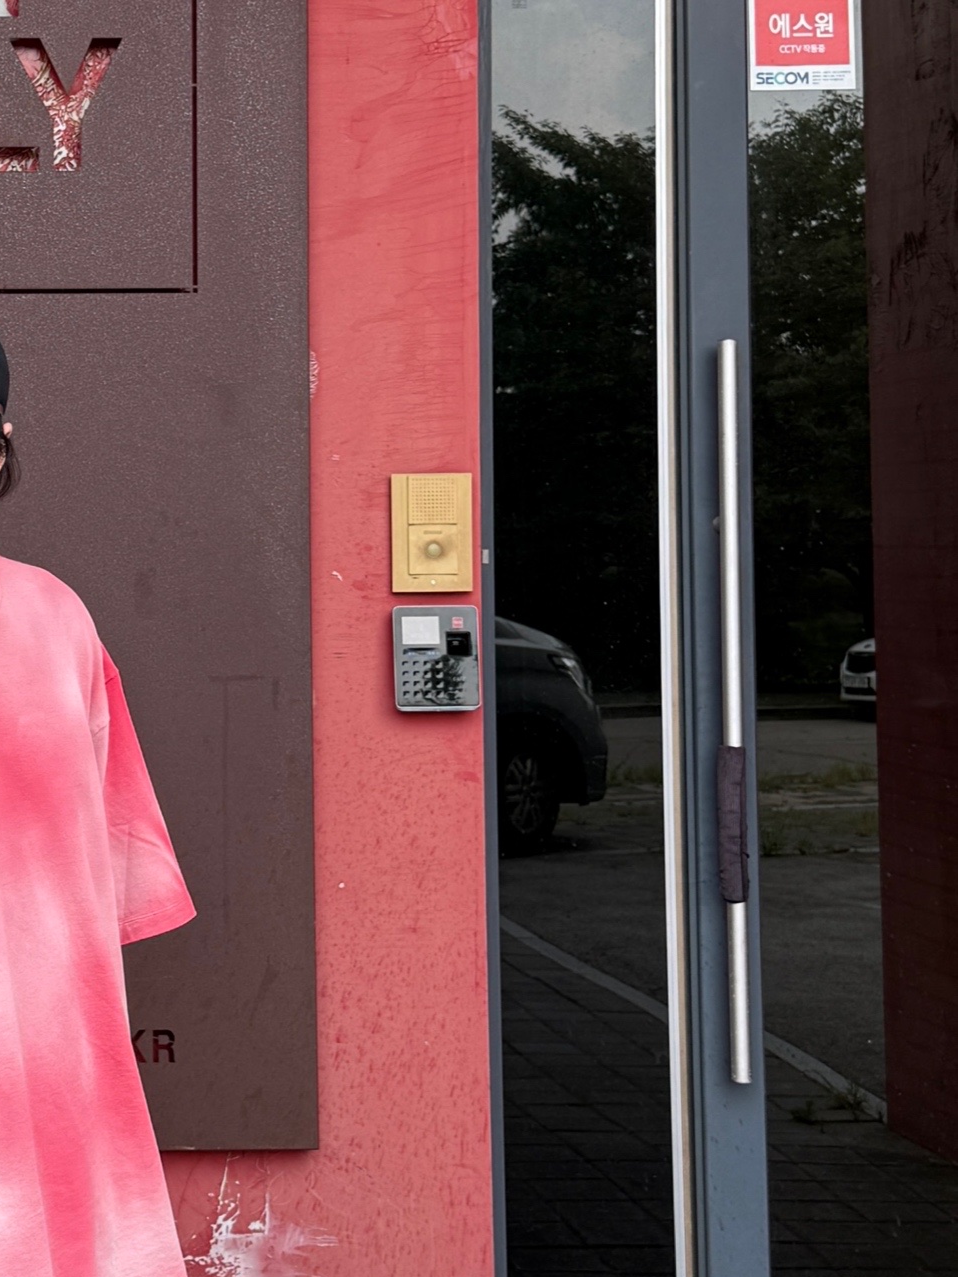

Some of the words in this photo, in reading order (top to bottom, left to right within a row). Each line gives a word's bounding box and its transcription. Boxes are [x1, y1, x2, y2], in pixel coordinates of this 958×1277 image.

[769, 13, 834, 38] 에스원
[779, 45, 802, 53] CCTV
[756, 72, 809, 84] SECOM
